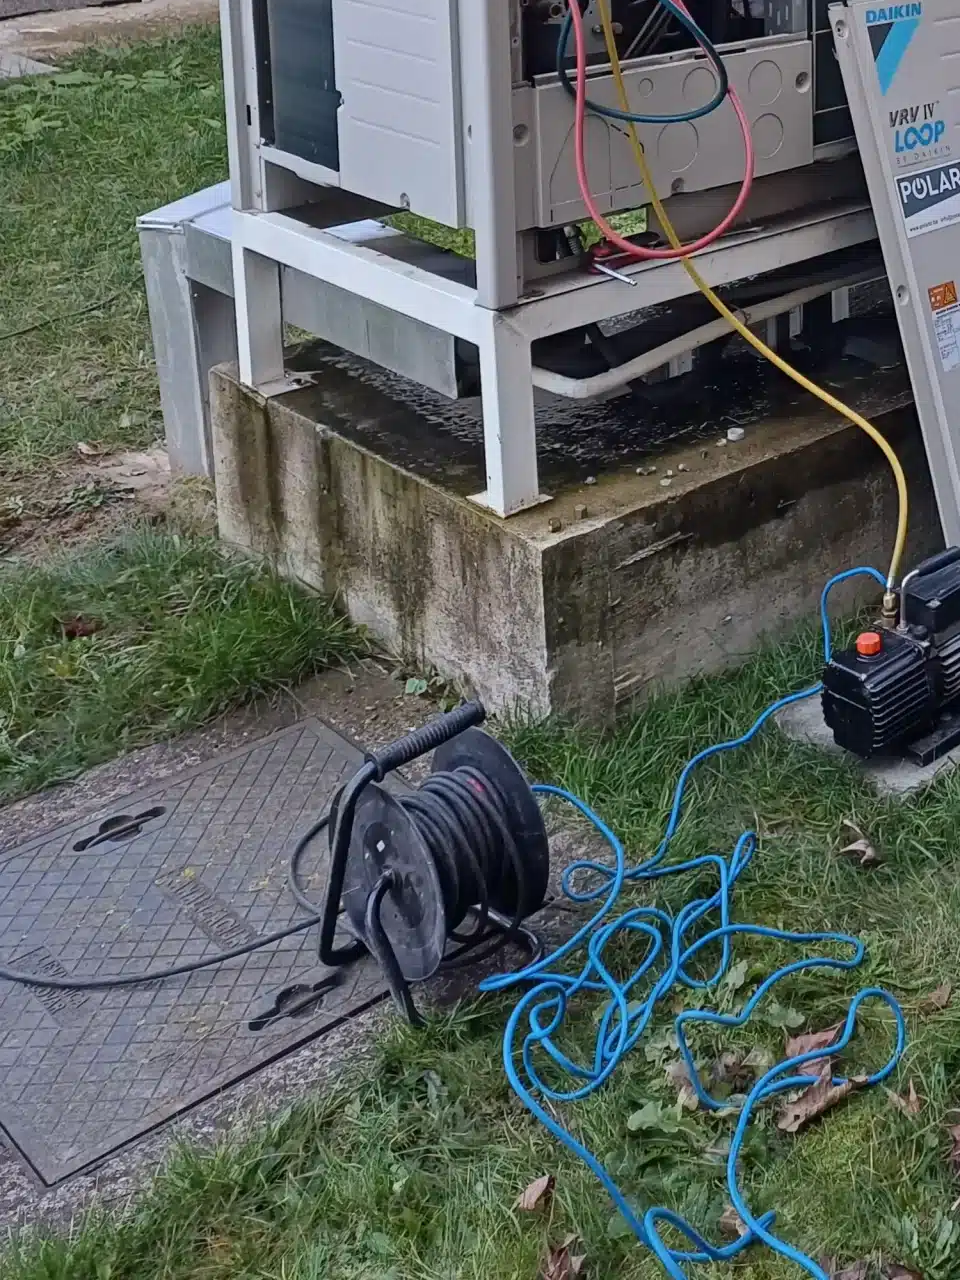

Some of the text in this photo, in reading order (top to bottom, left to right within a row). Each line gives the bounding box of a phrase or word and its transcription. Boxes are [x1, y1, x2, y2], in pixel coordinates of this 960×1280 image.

[865, 1, 922, 24] DAIKIN
[889, 104, 920, 128] VRV
[895, 120, 945, 153] LOOP
